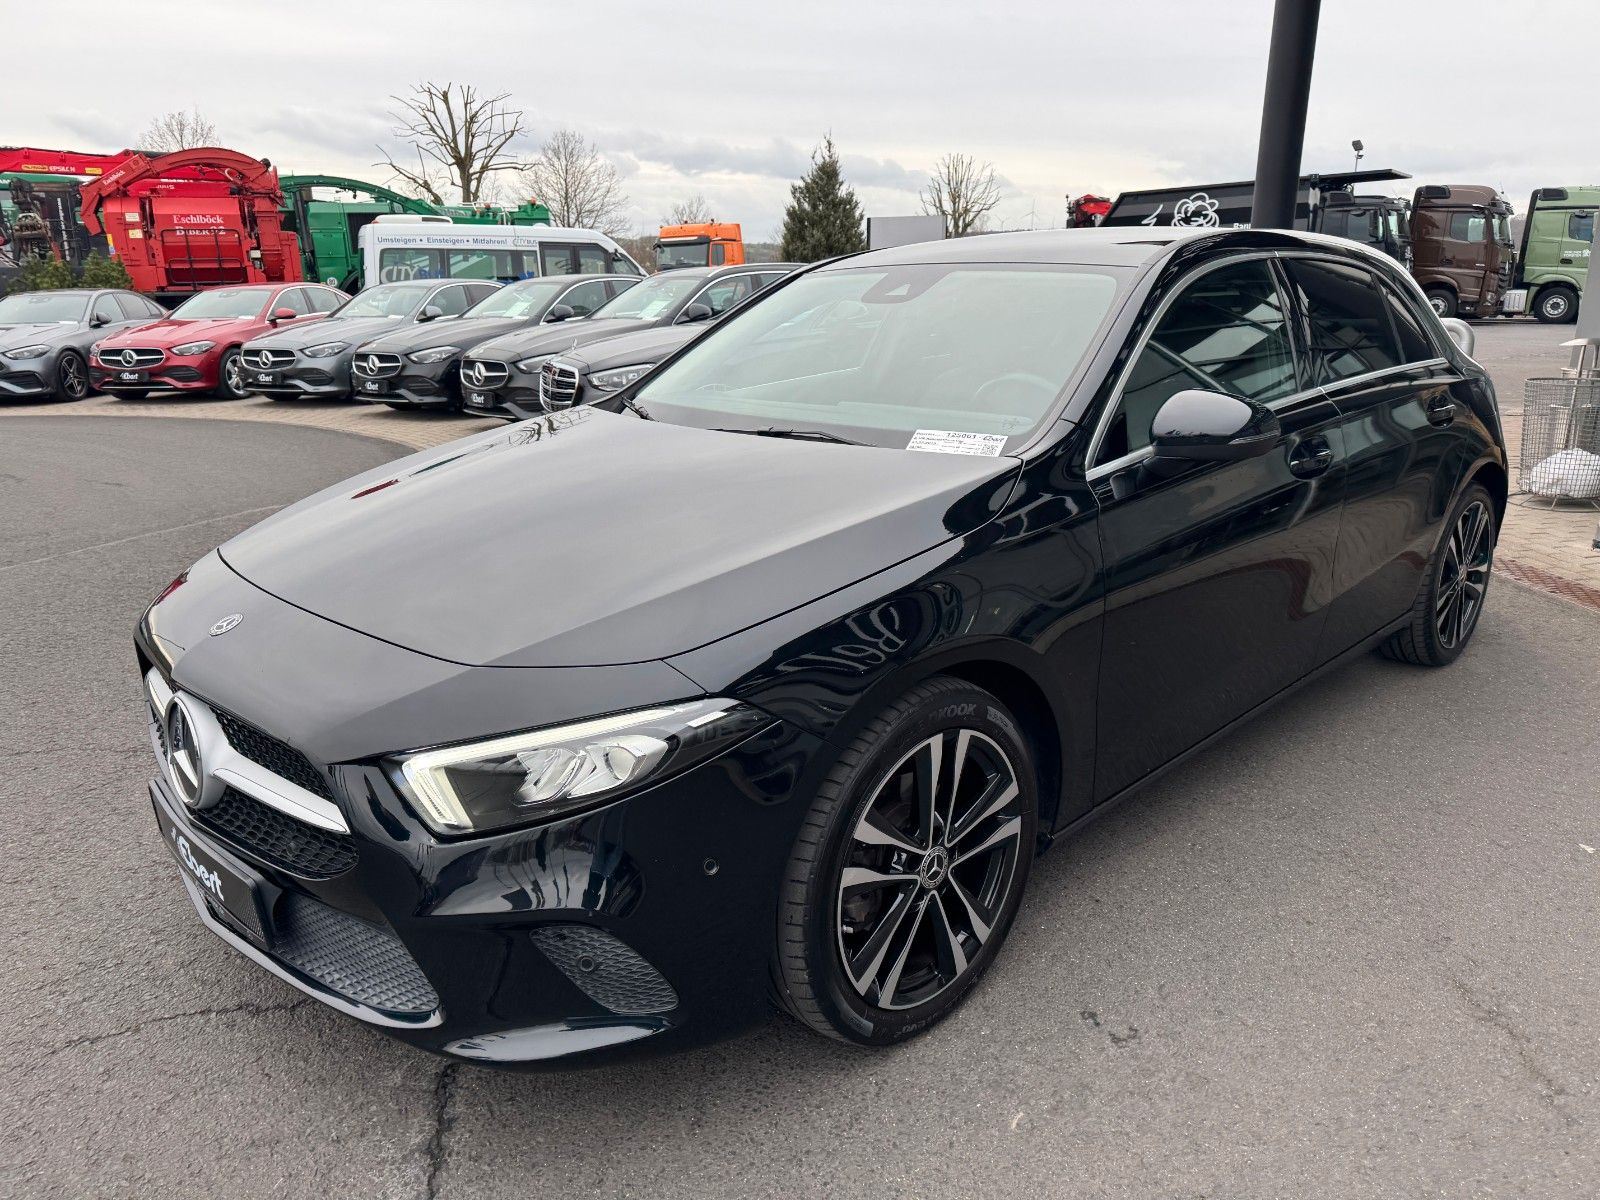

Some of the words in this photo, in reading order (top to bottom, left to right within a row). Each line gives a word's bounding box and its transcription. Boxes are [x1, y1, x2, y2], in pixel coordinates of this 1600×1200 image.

[173, 214, 224, 224] Eschlböck
[377, 236, 417, 245] Umsteigen
[427, 237, 465, 245] Einsteigen
[174, 832, 225, 902] Ebert
